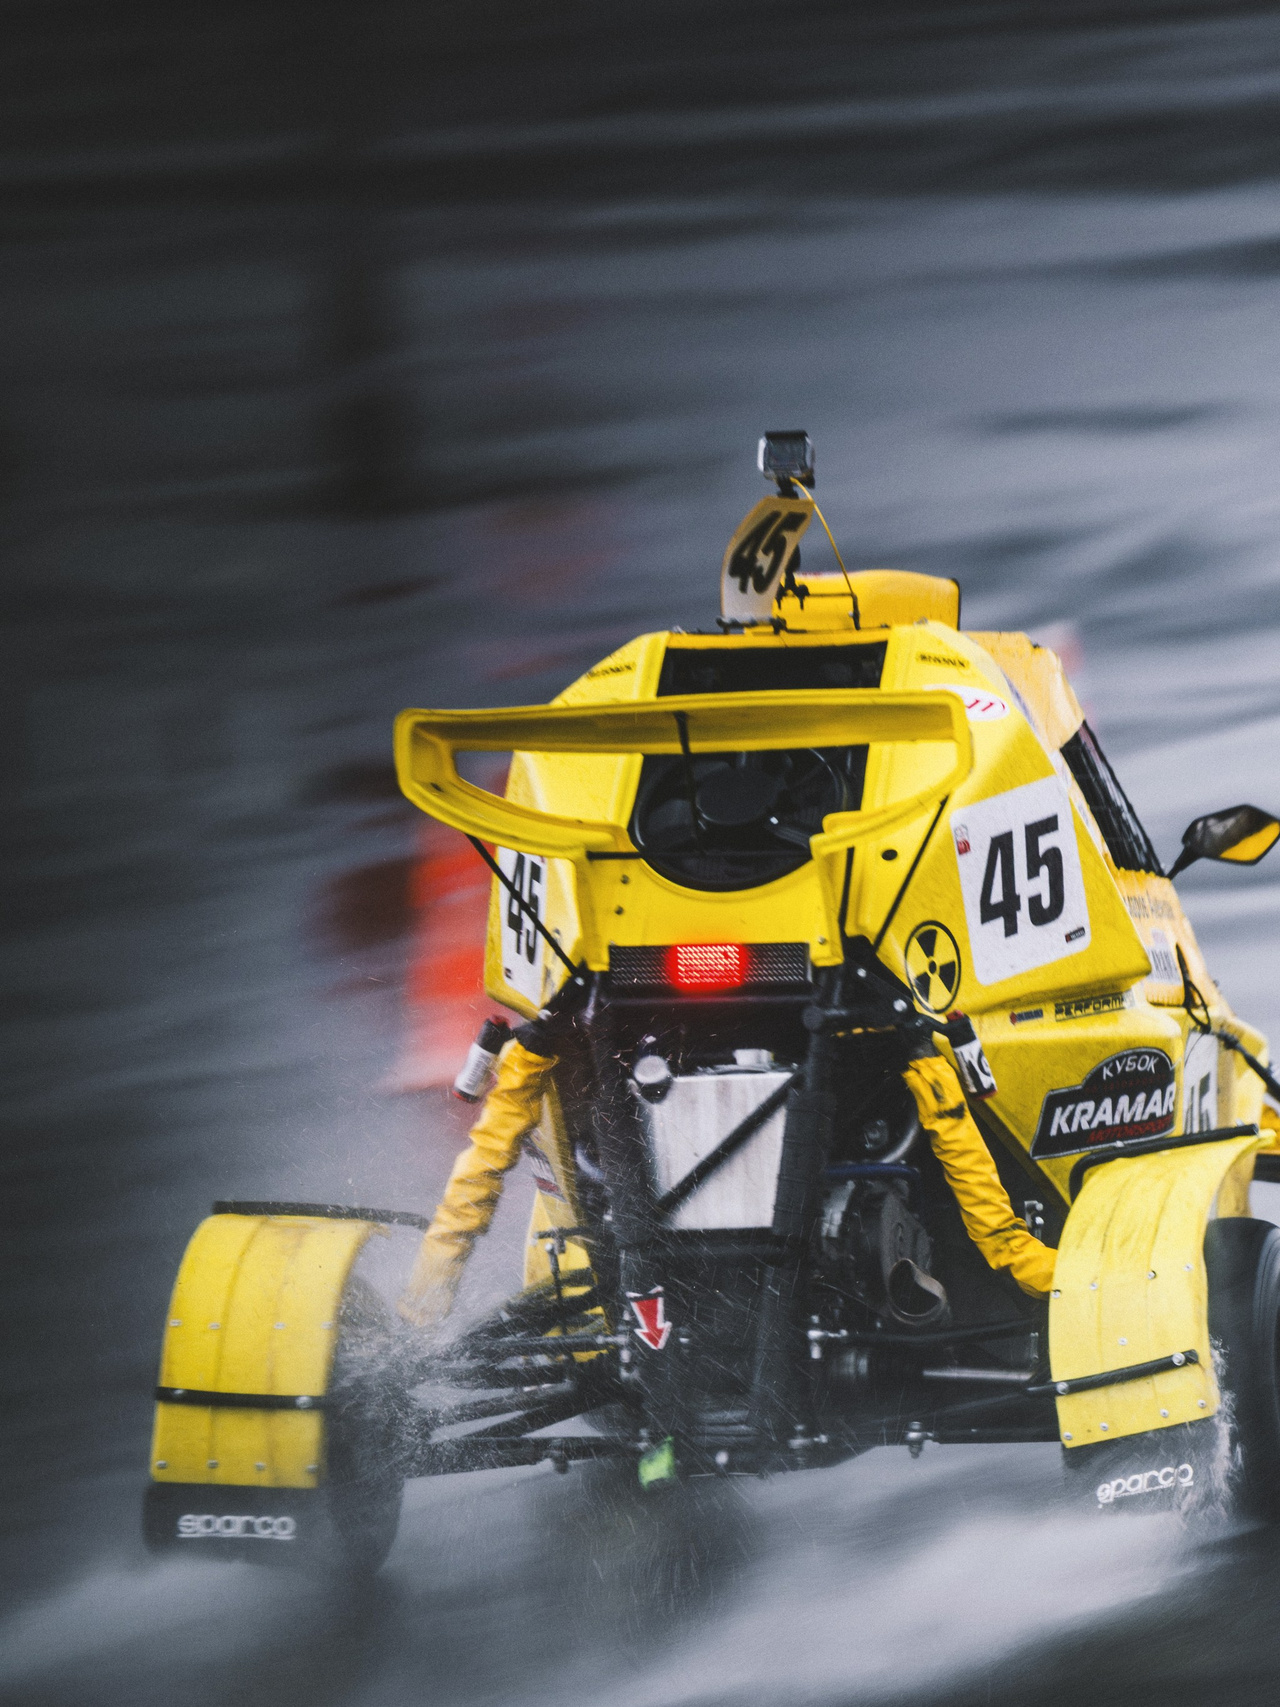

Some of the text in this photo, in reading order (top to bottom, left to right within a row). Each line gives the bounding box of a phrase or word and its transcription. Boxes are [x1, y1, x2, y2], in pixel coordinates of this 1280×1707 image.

[729, 510, 808, 594] 45
[980, 813, 1065, 938] 45
[507, 851, 542, 966] 45
[1103, 1055, 1159, 1080] КУБОК
[1050, 1082, 1176, 1136] KRAMAR
[1097, 1463, 1194, 1503] sparco
[177, 1514, 297, 1539] sparco
